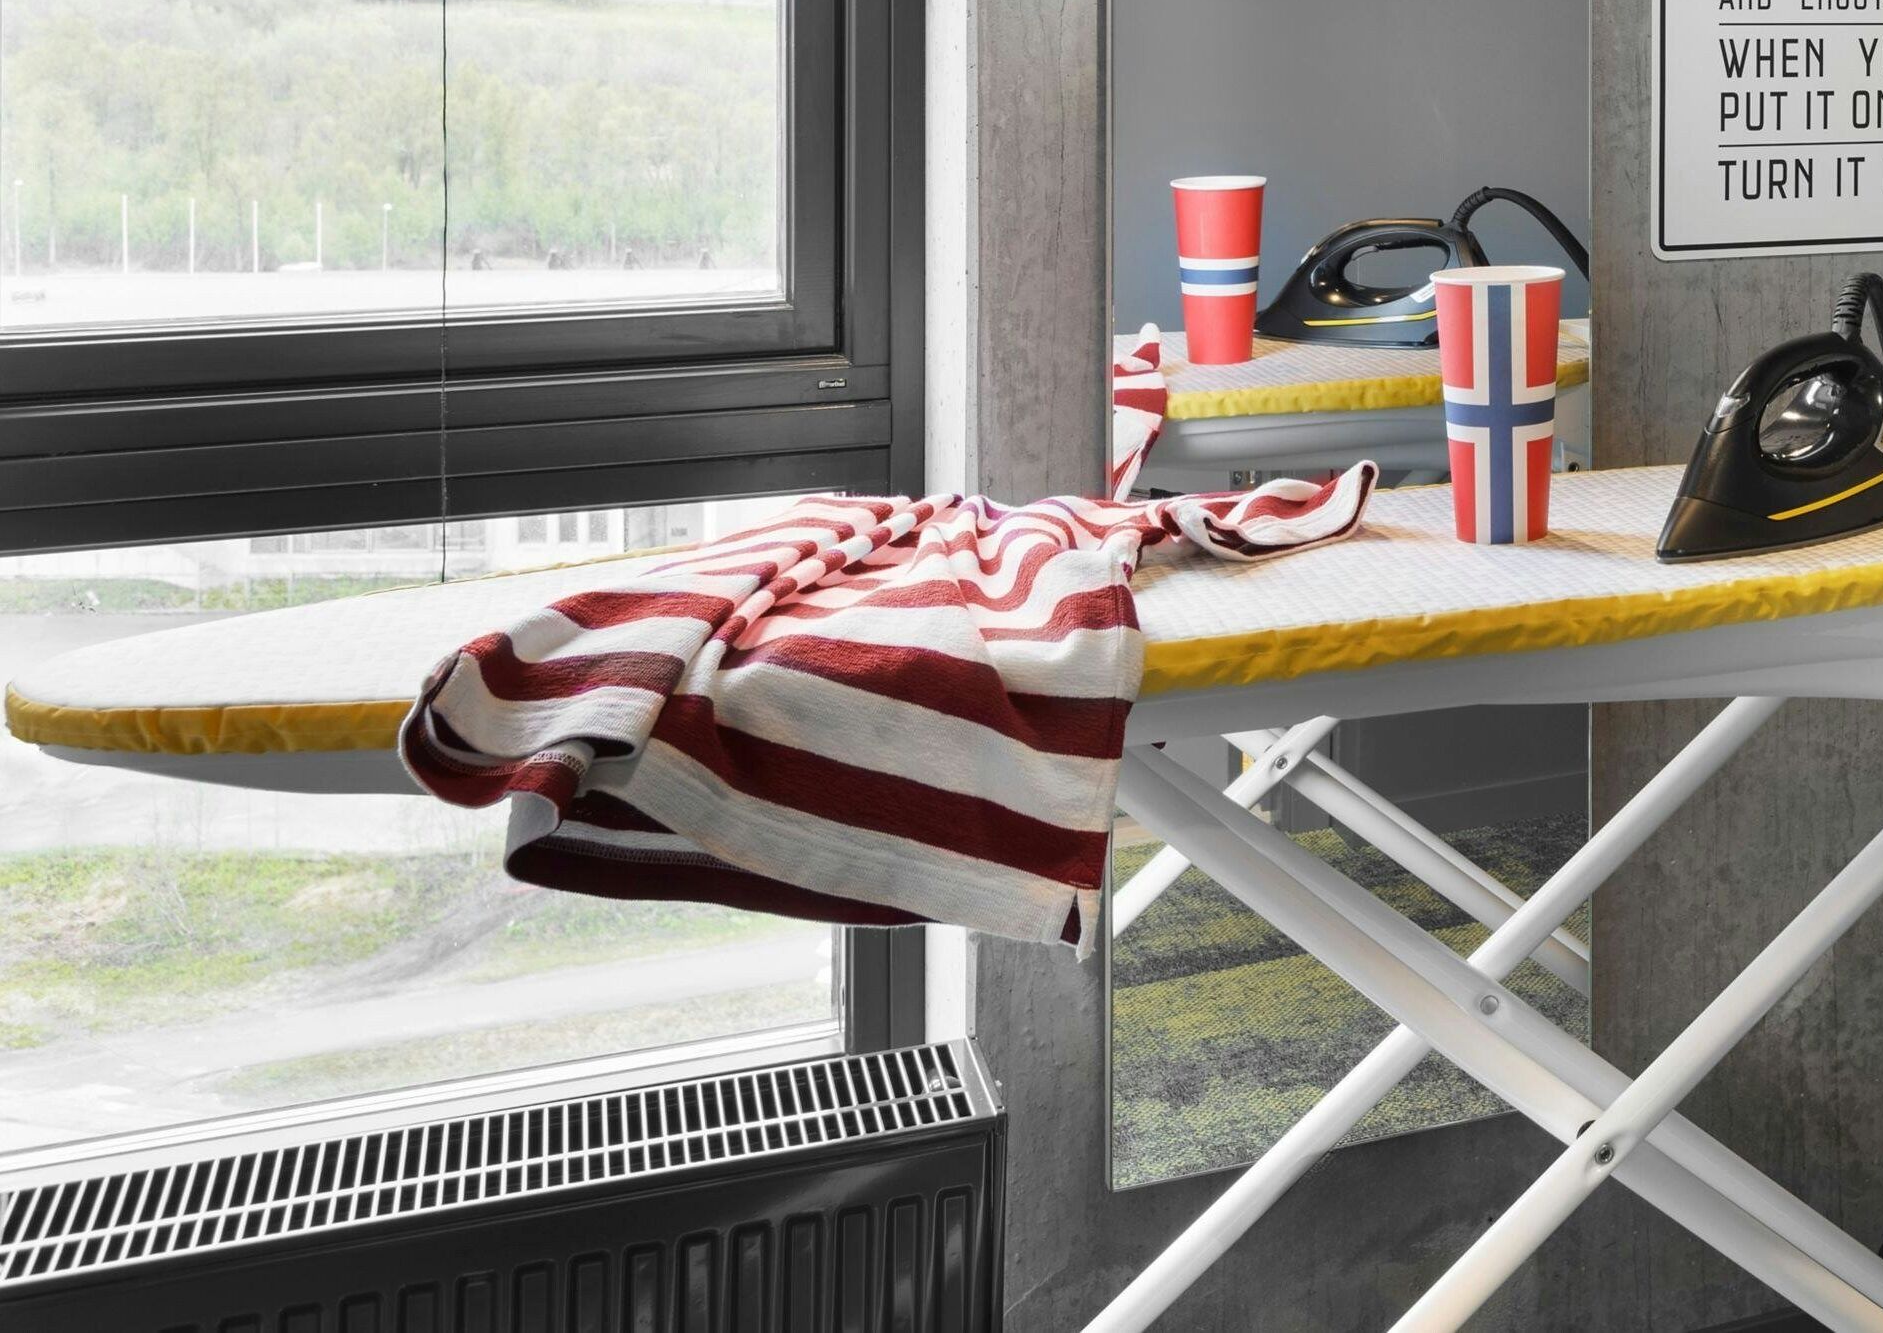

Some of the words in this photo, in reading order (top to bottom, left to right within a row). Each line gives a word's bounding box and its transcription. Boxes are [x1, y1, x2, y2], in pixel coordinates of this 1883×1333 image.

[1719, 39, 1823, 78] WHEN
[1721, 92, 1787, 131] PUT
[1807, 91, 1834, 129] IT
[1718, 159, 1812, 200] TURN
[1837, 157, 1865, 197] IT
